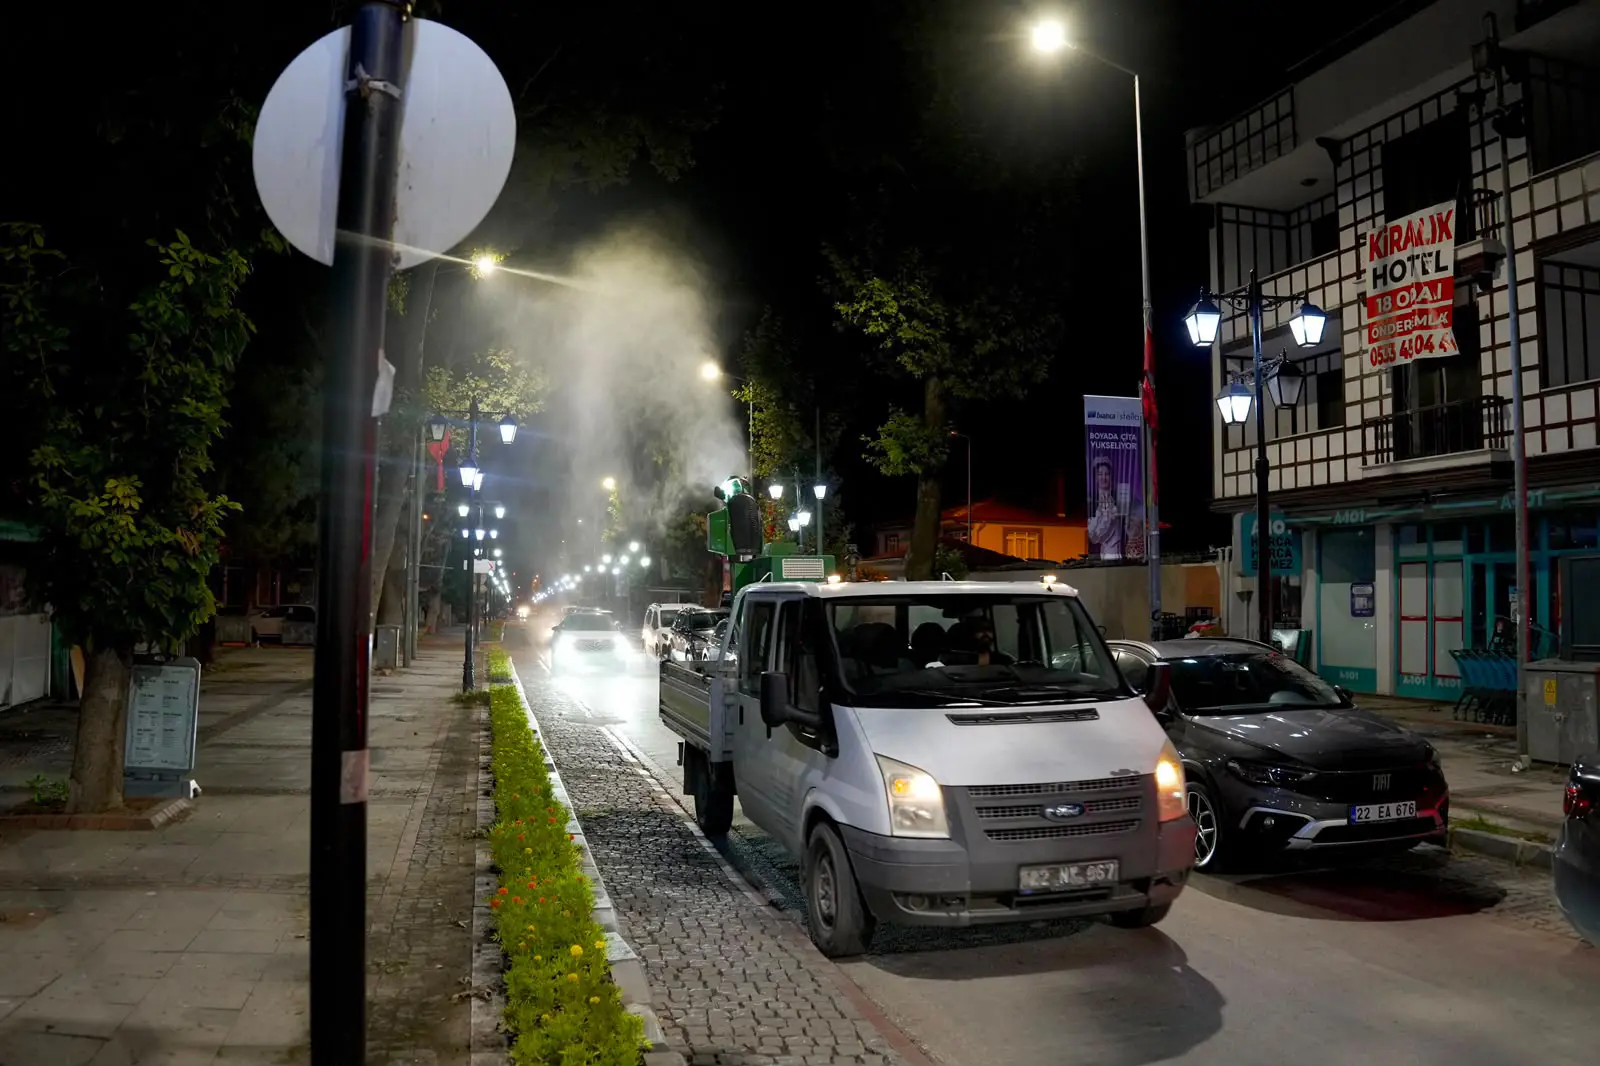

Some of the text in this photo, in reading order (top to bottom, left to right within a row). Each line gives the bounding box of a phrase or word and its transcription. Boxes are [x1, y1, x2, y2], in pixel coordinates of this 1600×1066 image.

[1372, 250, 1449, 290] HOTEL
[1376, 297, 1393, 314] 18
[1089, 432, 1119, 440] BOYADA
[1250, 536, 1293, 547] HRCA
[1250, 547, 1293, 558] HRCA
[1356, 802, 1415, 820] 22 EA 676
